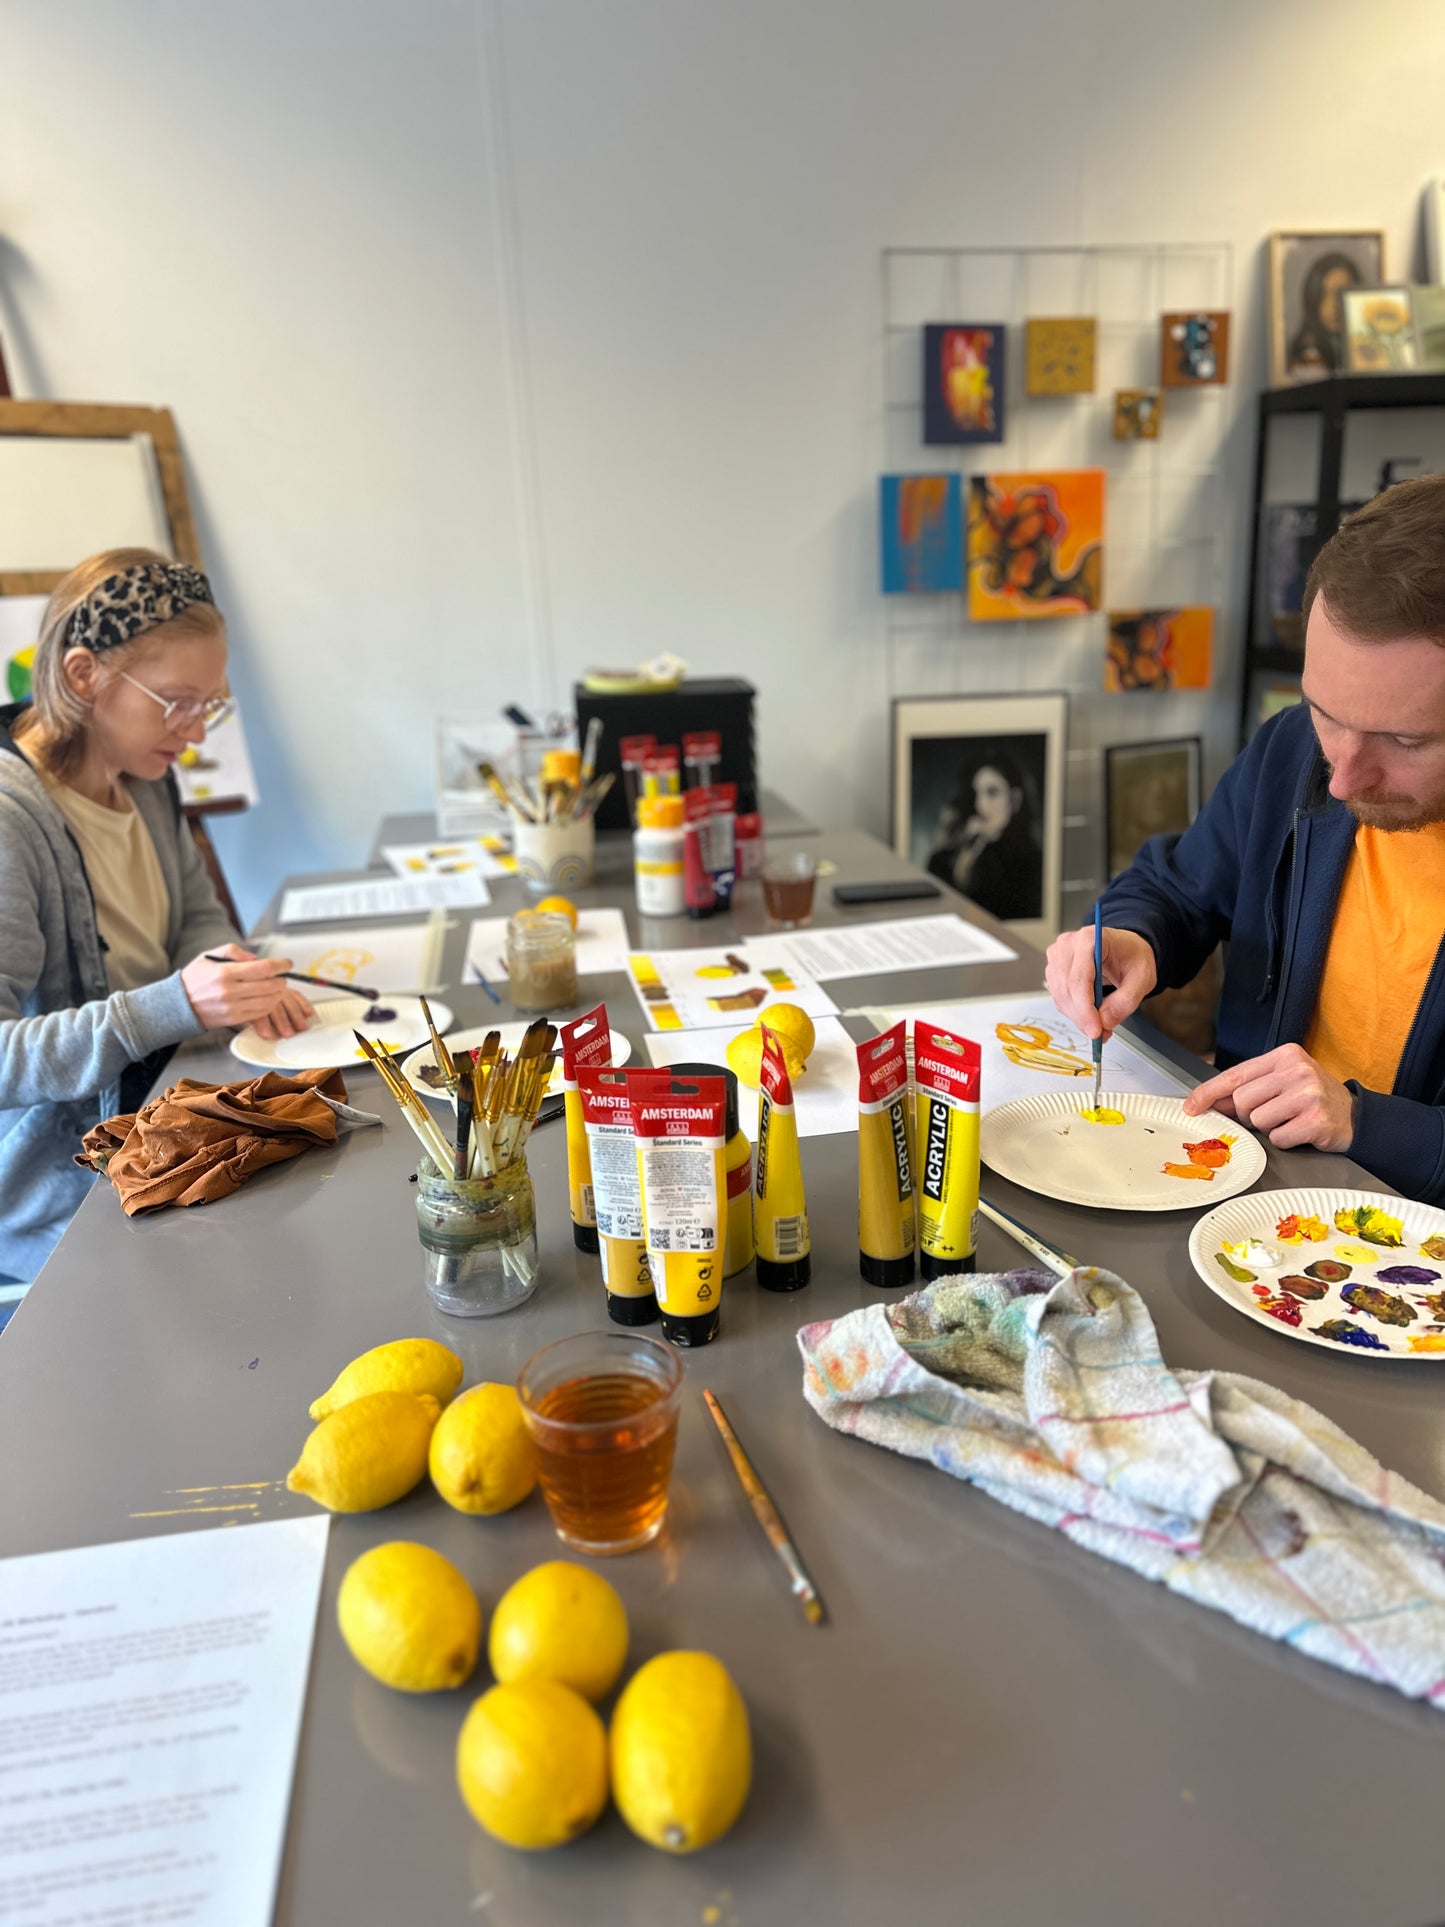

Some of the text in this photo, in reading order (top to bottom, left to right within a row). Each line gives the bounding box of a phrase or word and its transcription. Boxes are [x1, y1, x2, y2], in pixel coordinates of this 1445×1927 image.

[574, 1034, 609, 1062] AMSTERDAM
[869, 1056, 904, 1085] AMSTERDAM
[918, 1056, 969, 1085] AMSTERDAM
[641, 1108, 713, 1120] AMSTERDAM
[652, 1137, 703, 1146] Standard Series
[757, 1106, 769, 1194] ACRYLIC
[892, 1104, 912, 1193] ACRYLIC
[926, 1104, 947, 1196] ACRYLIC
